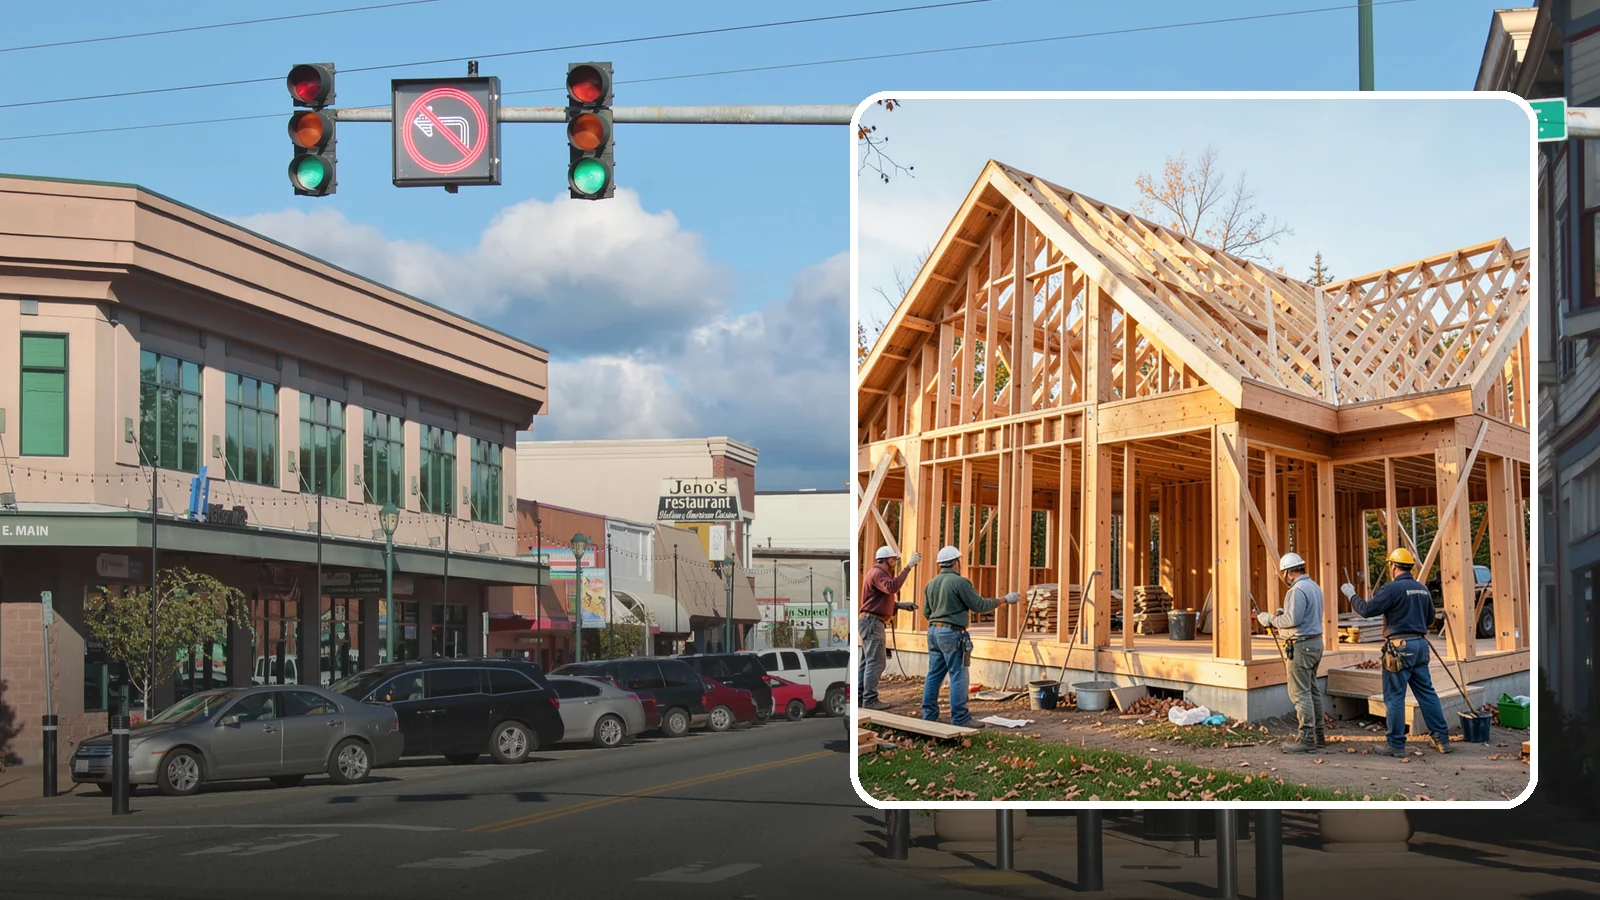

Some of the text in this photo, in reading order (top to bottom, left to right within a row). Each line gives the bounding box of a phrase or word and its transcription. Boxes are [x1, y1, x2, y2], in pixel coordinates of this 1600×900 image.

[669, 480, 728, 495] Jeno's
[665, 496, 731, 509] restaurant
[658, 510, 681, 520] Italian
[686, 510, 714, 520] American
[714, 509, 738, 520] Cuisine
[2, 525, 49, 536] E. MAIN
[797, 607, 829, 617] Street
[790, 619, 824, 628] lass
